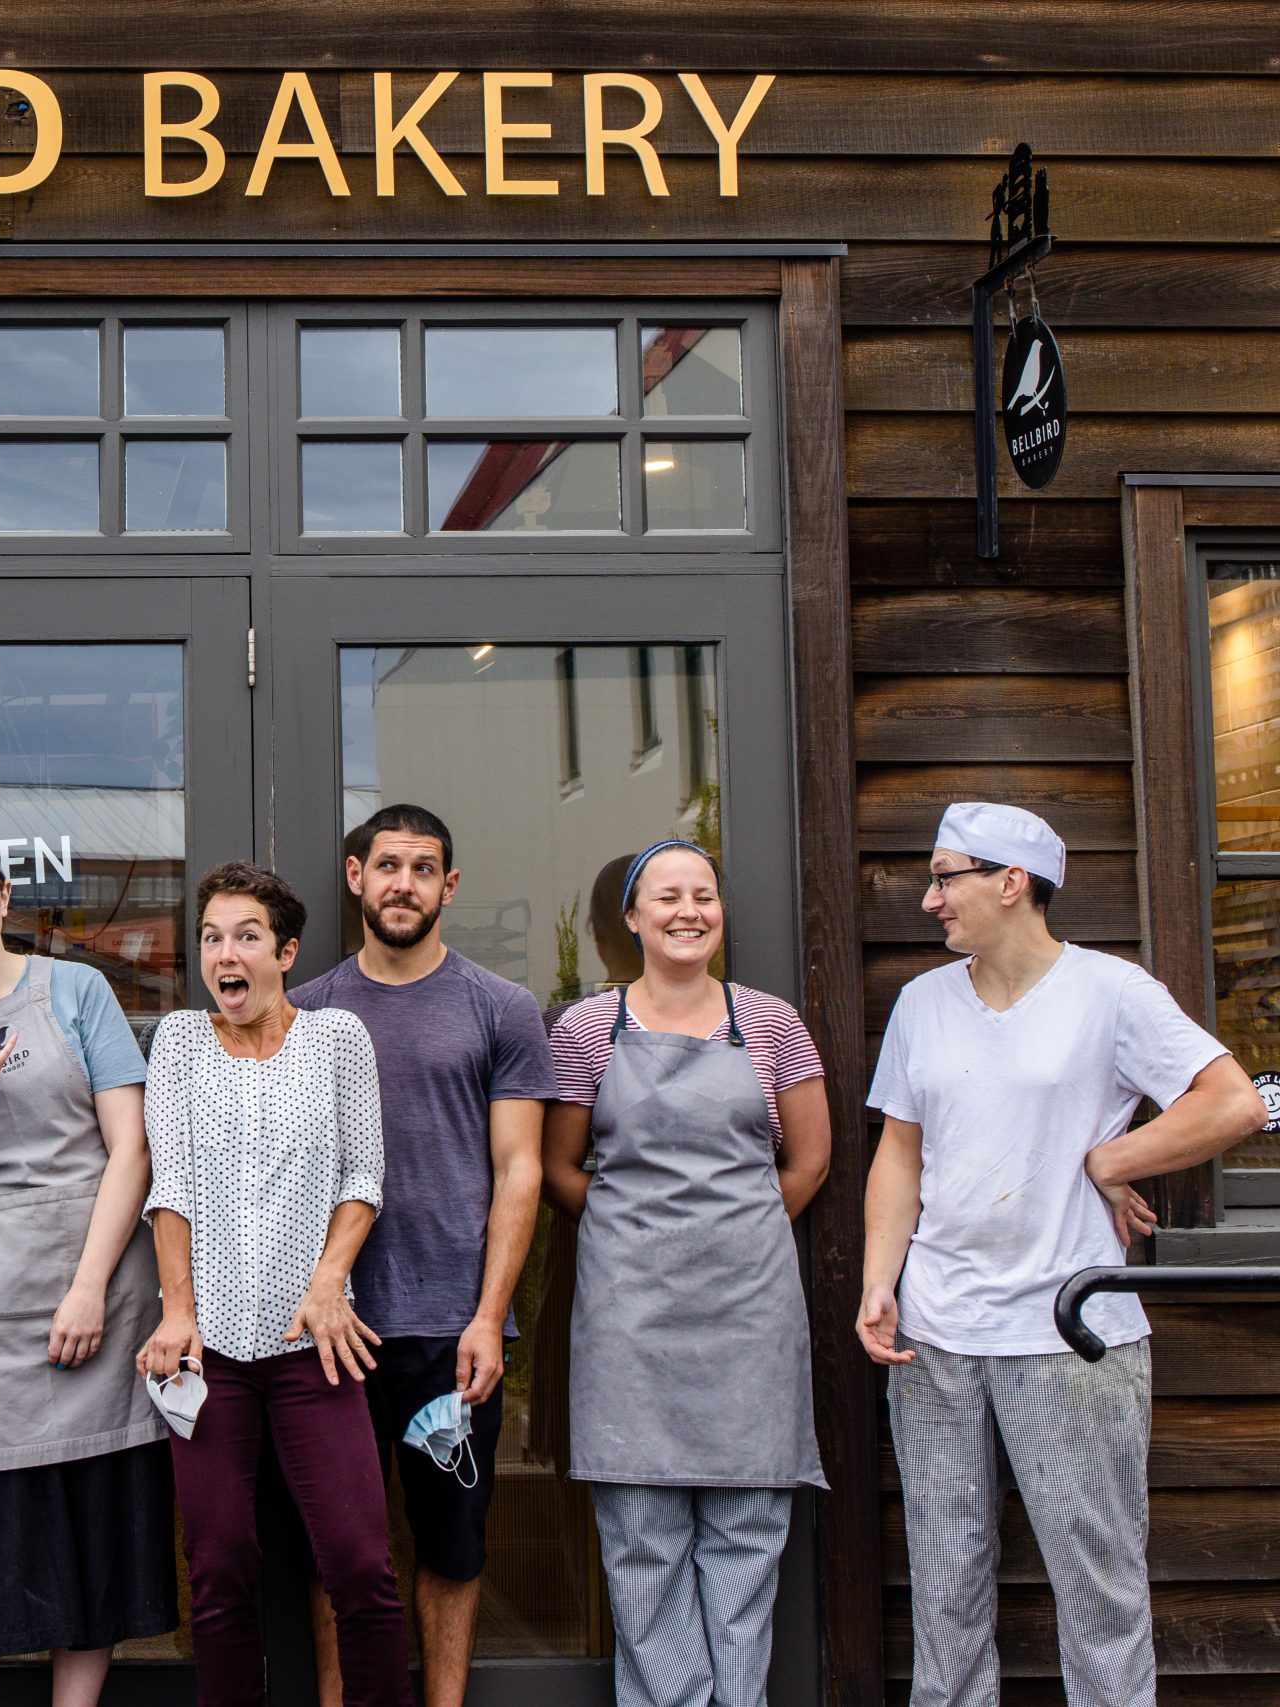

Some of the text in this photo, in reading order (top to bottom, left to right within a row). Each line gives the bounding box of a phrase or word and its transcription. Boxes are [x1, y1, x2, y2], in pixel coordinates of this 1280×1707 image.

[143, 71, 776, 196] BAKERY
[1012, 419, 1060, 456] BELLBIRD
[1022, 446, 1054, 467] BAKERY
[0, 836, 73, 885] EN
